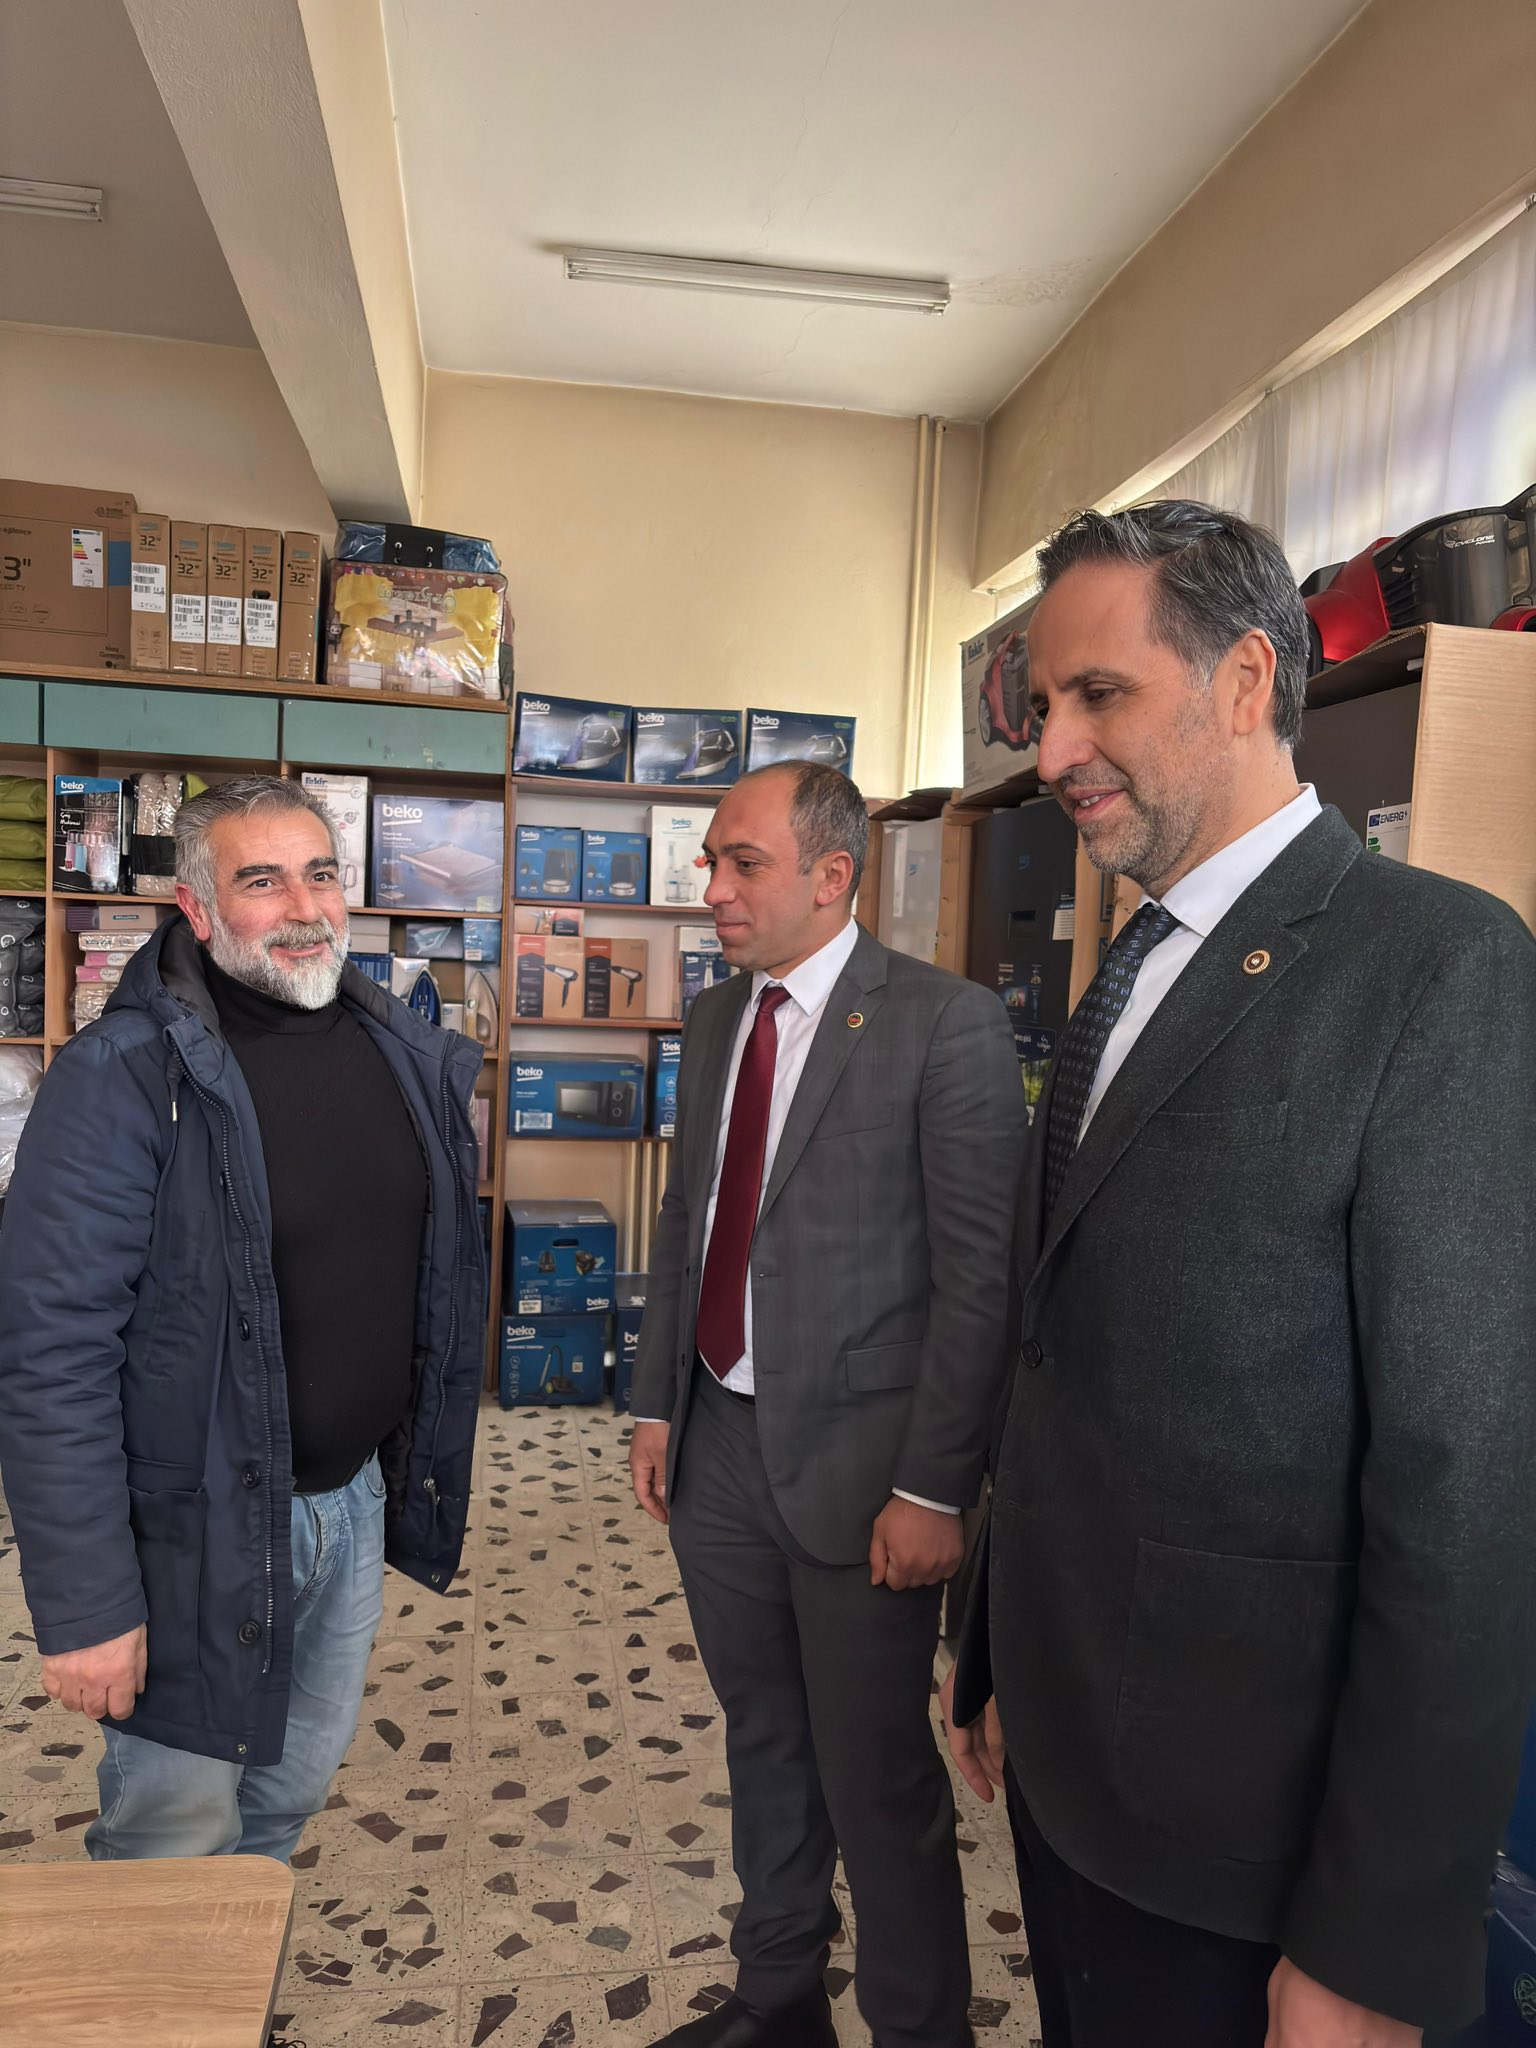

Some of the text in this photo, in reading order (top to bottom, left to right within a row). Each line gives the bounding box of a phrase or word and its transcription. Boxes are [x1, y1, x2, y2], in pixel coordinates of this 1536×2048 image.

[139, 535, 162, 547] 32"
[0, 556, 32, 582] 3"
[177, 562, 200, 575] 32"
[215, 565, 237, 577] 32"
[252, 567, 273, 580] 32"
[522, 698, 550, 712] beko
[638, 712, 665, 724] beko
[752, 714, 780, 726] beko
[61, 780, 85, 790] beko
[382, 803, 424, 819] beko
[521, 830, 540, 839] beko
[587, 834, 607, 842] beko
[700, 937, 719, 945] beko
[662, 1041, 681, 1052] bek
[516, 1066, 544, 1077] beko
[586, 1297, 610, 1307] beko
[506, 1325, 536, 1336] beko
[624, 1331, 640, 1344] be
